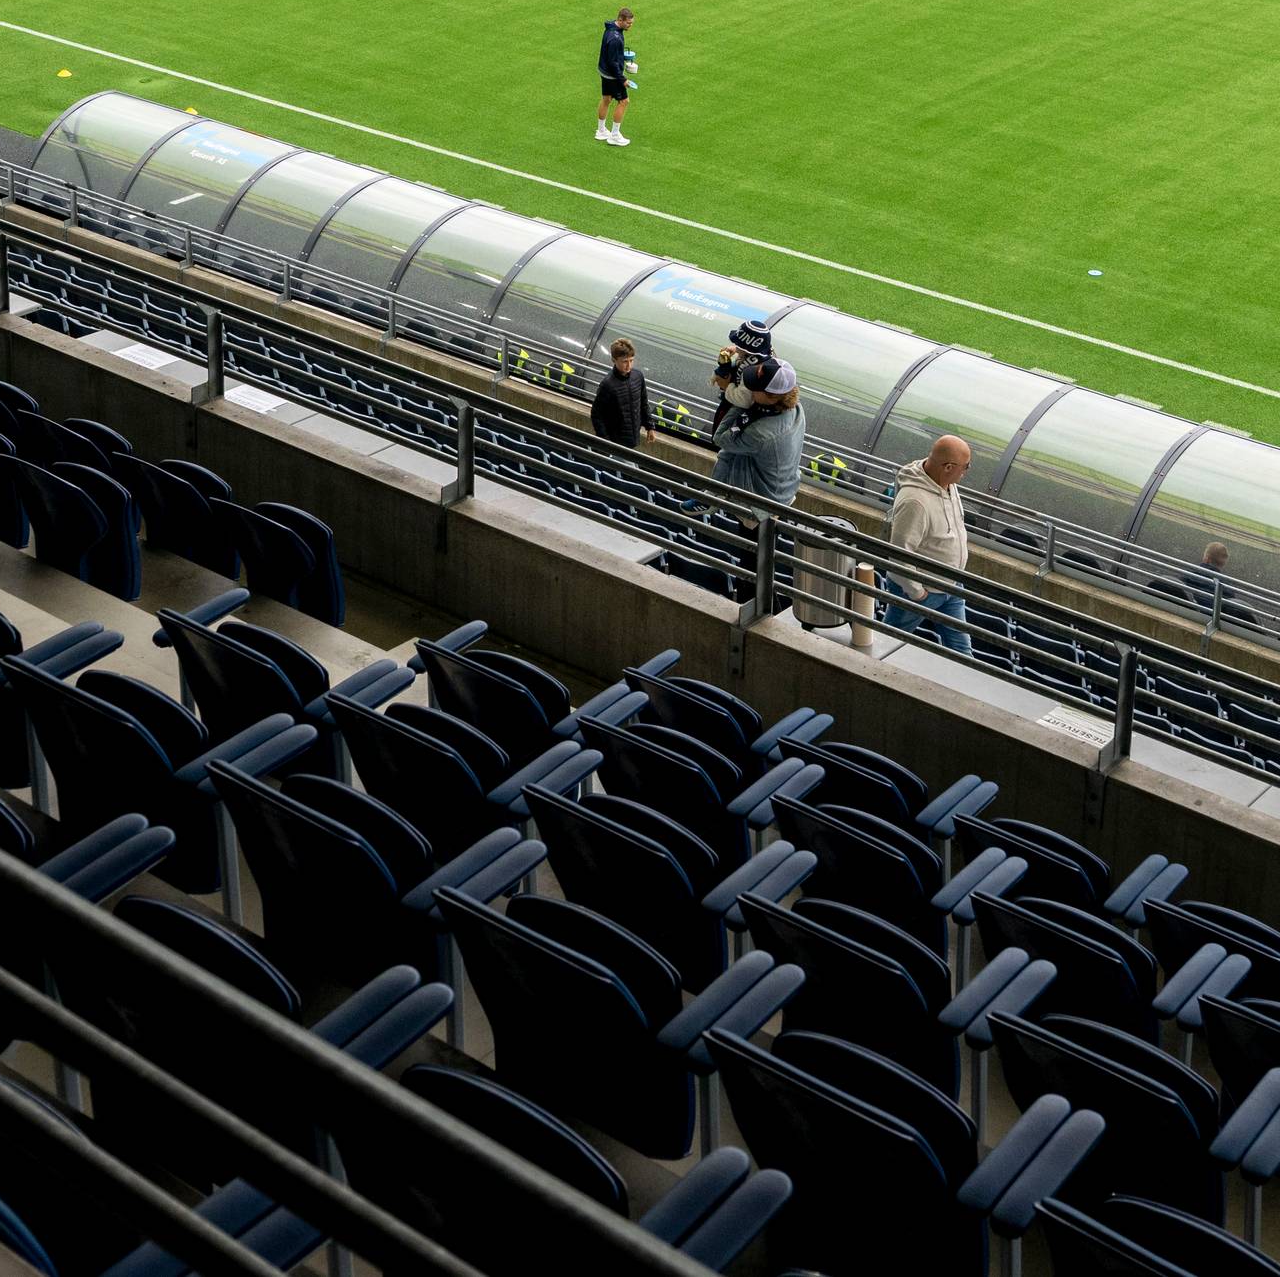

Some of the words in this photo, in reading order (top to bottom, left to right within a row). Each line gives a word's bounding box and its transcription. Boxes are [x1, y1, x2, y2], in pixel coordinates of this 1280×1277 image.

[678, 288, 730, 310] NorEngros
[702, 309, 717, 321] AS
[1044, 717, 1107, 744] RESERVERT
